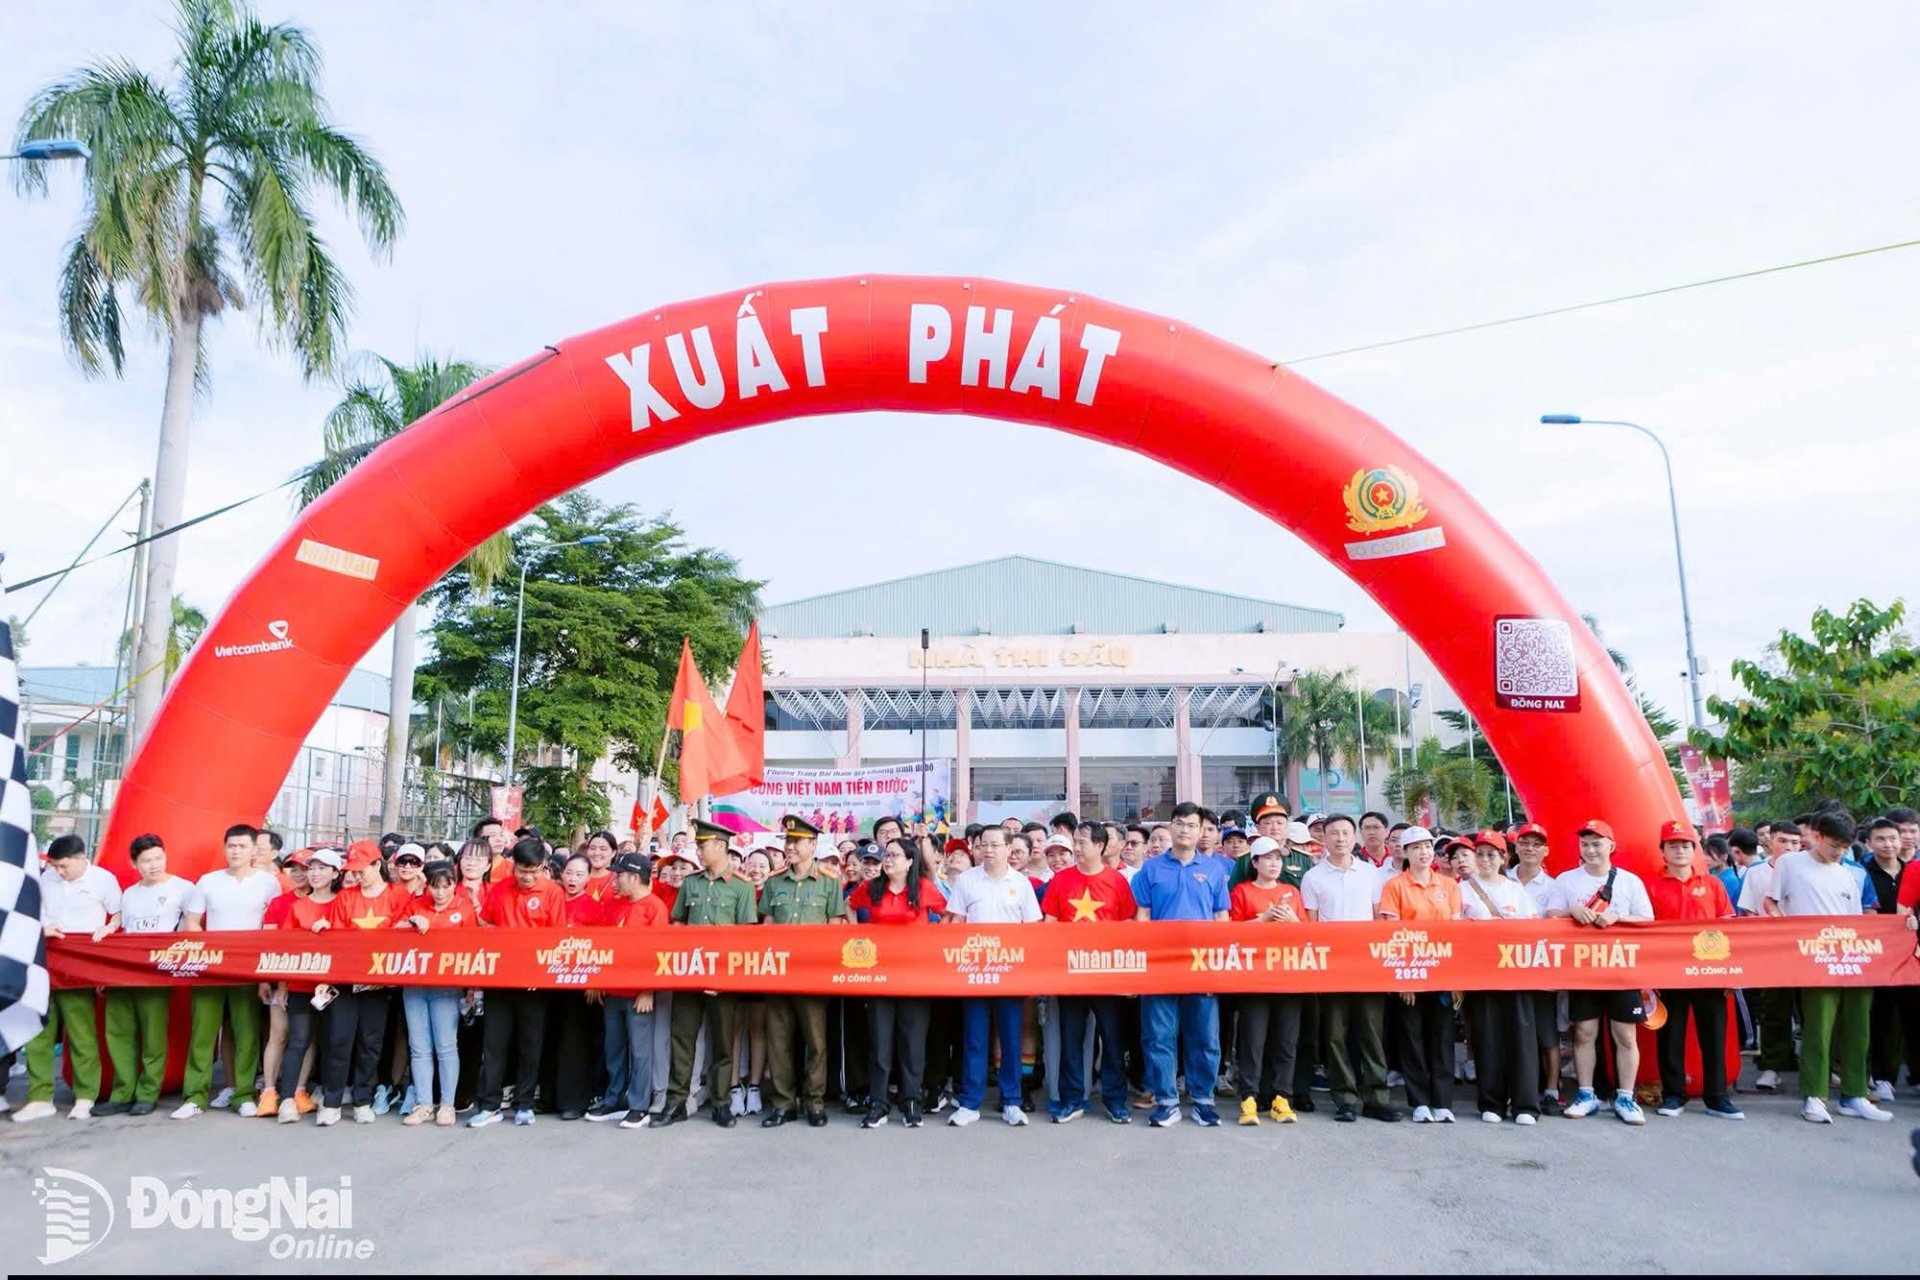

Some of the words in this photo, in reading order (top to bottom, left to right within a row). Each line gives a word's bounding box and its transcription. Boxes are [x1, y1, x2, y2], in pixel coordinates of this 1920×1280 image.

[604, 291, 828, 432] XUẤT
[909, 303, 1121, 407] PHÁT
[215, 638, 295, 658] Vietcombank
[908, 643, 984, 668] NHÀ
[995, 648, 1049, 667] THI
[1511, 697, 1542, 709] ĐỒNG
[1544, 699, 1566, 709] NAI
[786, 778, 811, 799] VIỆT
[814, 781, 843, 796] NAM
[846, 777, 873, 796] TIẾN
[986, 947, 1024, 963] NAM
[1412, 941, 1452, 958] NAM
[1497, 938, 1565, 968] XUẤT
[1573, 938, 1640, 968] PHÁT
[1840, 939, 1883, 954] NAM
[187, 950, 223, 965] NAM
[368, 947, 433, 975] XUẤT
[438, 948, 501, 975] PHÁT
[576, 949, 614, 965] NAM
[655, 947, 719, 976] XUẤT
[727, 947, 790, 976] PHÁT
[1067, 949, 1111, 969] Nhân
[1190, 942, 1257, 972] XUẤT
[1265, 942, 1331, 971] PHÁT
[833, 973, 846, 984] BỘ
[847, 973, 872, 983] CÔNG
[873, 975, 887, 983] AN
[1684, 966, 1699, 976] BỘ
[1700, 966, 1728, 975] CÔNG
[1729, 966, 1743, 974] AN
